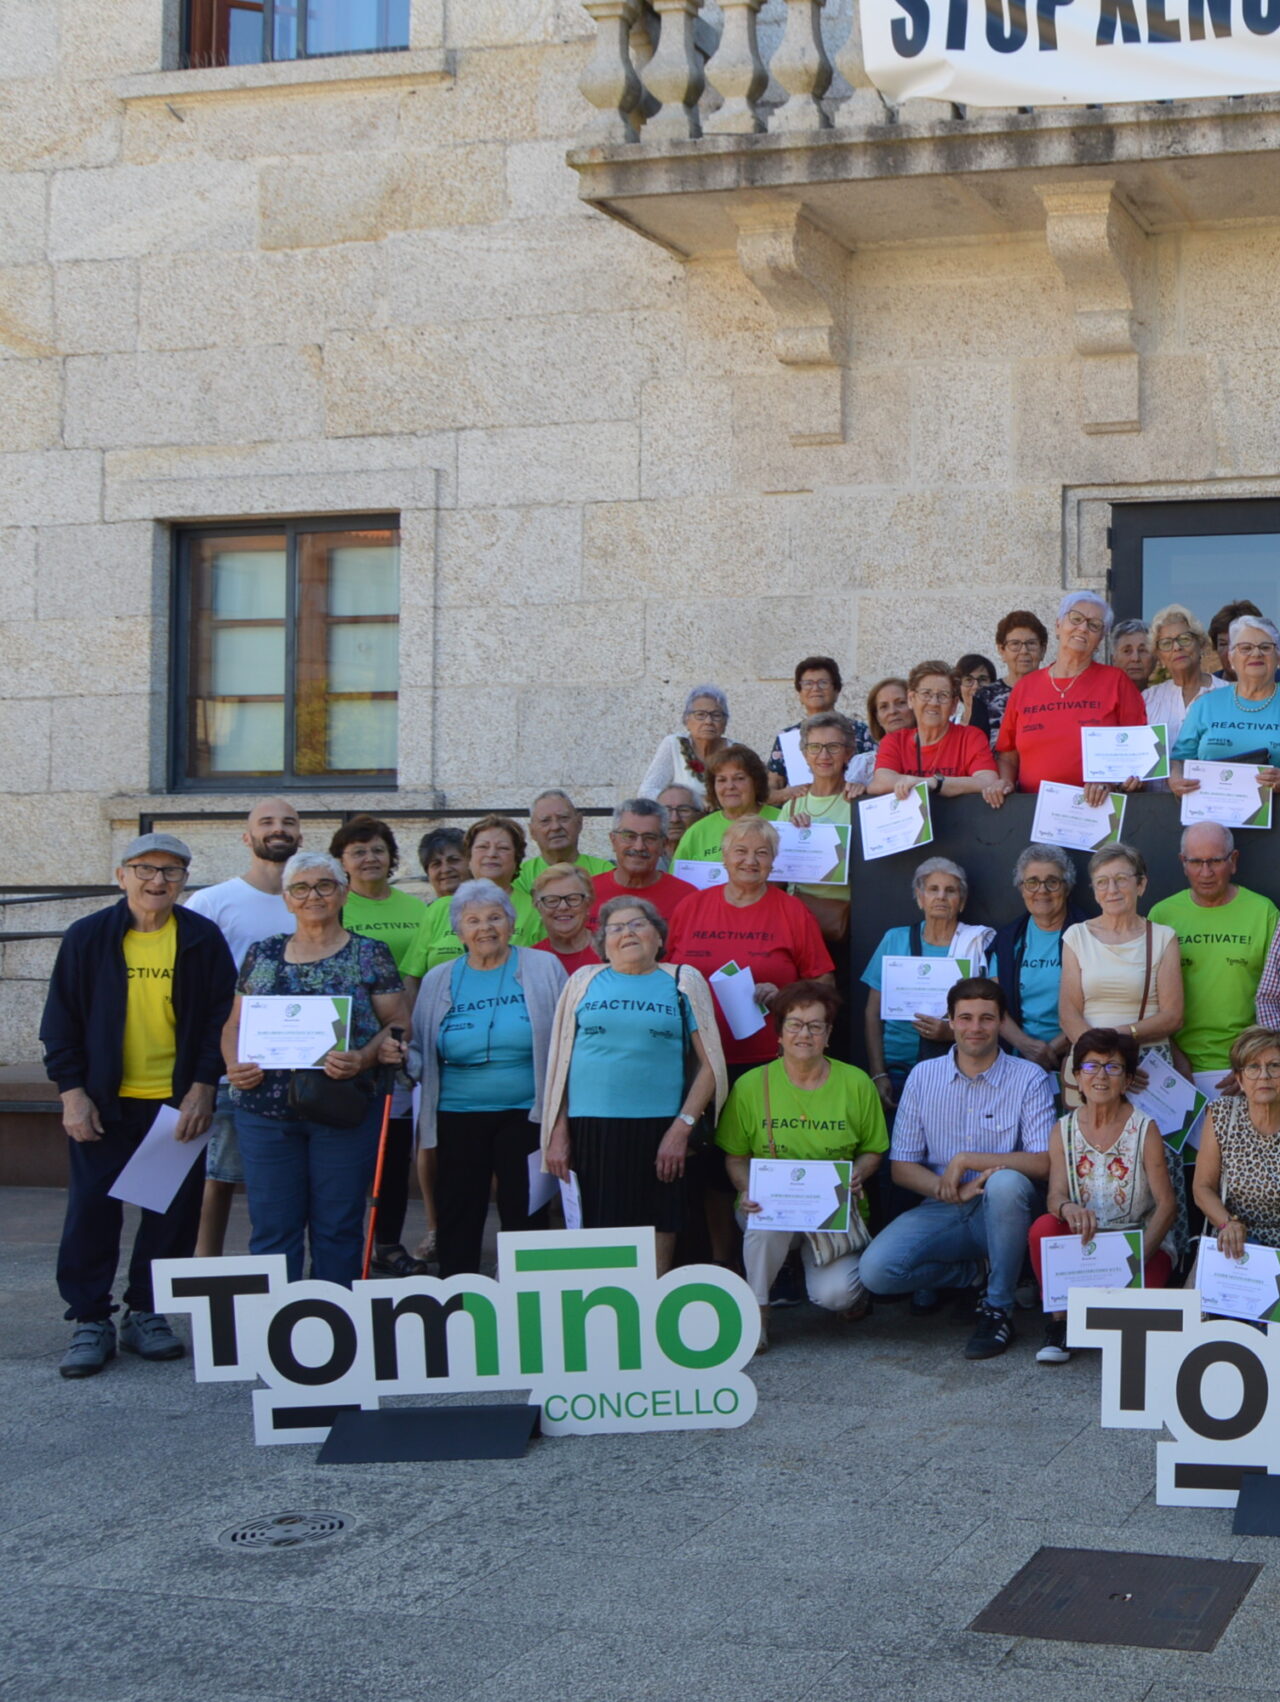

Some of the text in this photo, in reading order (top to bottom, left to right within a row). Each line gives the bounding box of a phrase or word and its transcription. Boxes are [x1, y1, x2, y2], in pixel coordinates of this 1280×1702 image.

[1023, 700, 1102, 714] REACTIVATE!
[692, 930, 774, 943] REACTIVATE!
[585, 999, 678, 1017] REACTIVATE!
[544, 1387, 740, 1423] CONCELLO
